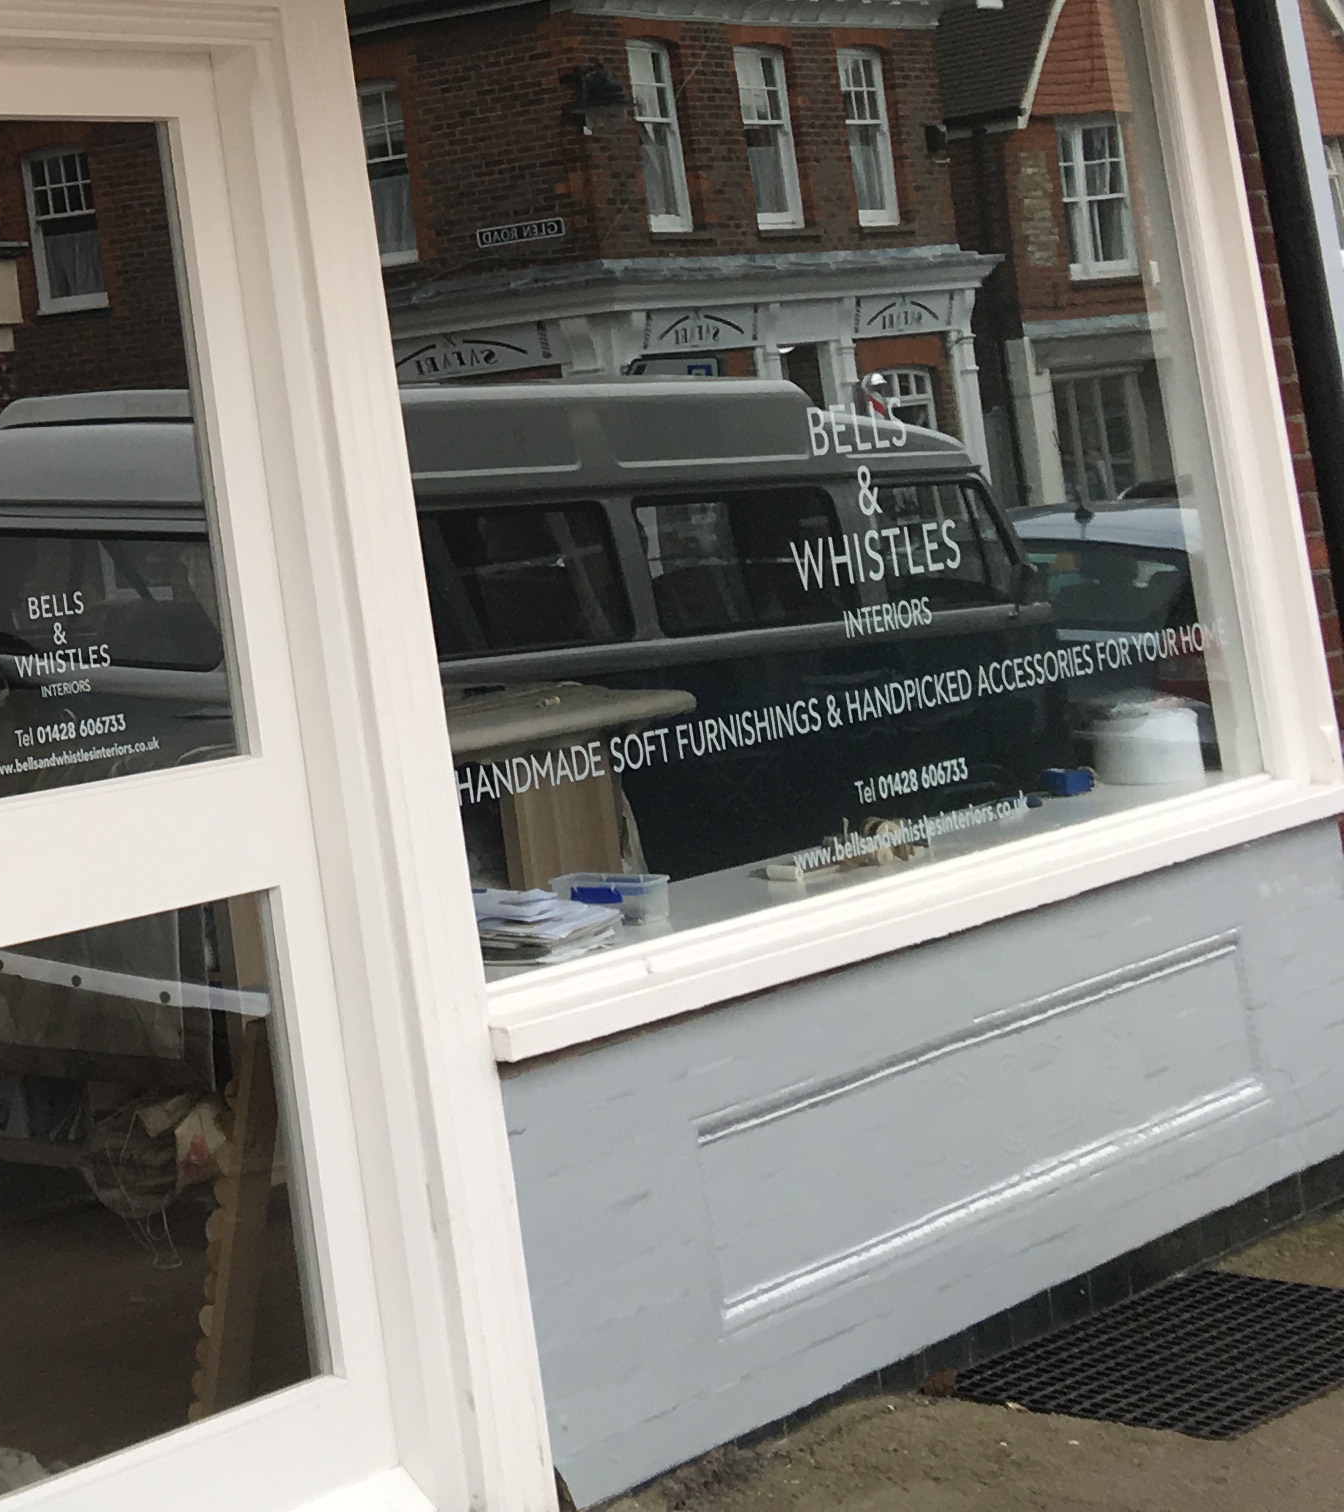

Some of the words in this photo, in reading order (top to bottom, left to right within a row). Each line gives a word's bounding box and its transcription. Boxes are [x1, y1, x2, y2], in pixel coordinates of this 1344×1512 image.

[805, 396, 907, 457] BELLS
[857, 464, 882, 517] &
[790, 519, 962, 593] WHISTLES
[27, 590, 85, 620] BELLS
[843, 595, 933, 640] INTERIORS
[52, 621, 68, 646] &
[14, 643, 111, 679] WHISTLES
[40, 678, 92, 699] INTERIORS
[14, 727, 34, 748] Tel
[36, 720, 76, 744] 01428
[79, 713, 127, 738] 606733
[453, 739, 607, 808] HANDMADE
[610, 726, 671, 776] SOFT
[675, 697, 824, 763] FURNISHINGS
[826, 700, 844, 730] &
[845, 666, 974, 726] HANDPICKED
[977, 637, 1096, 699] ACCESSORIES
[1095, 637, 1133, 672] FOR
[1131, 627, 1180, 664] YOUR
[854, 778, 877, 806] Tel
[878, 769, 920, 801] 01428
[920, 756, 969, 793] 606733
